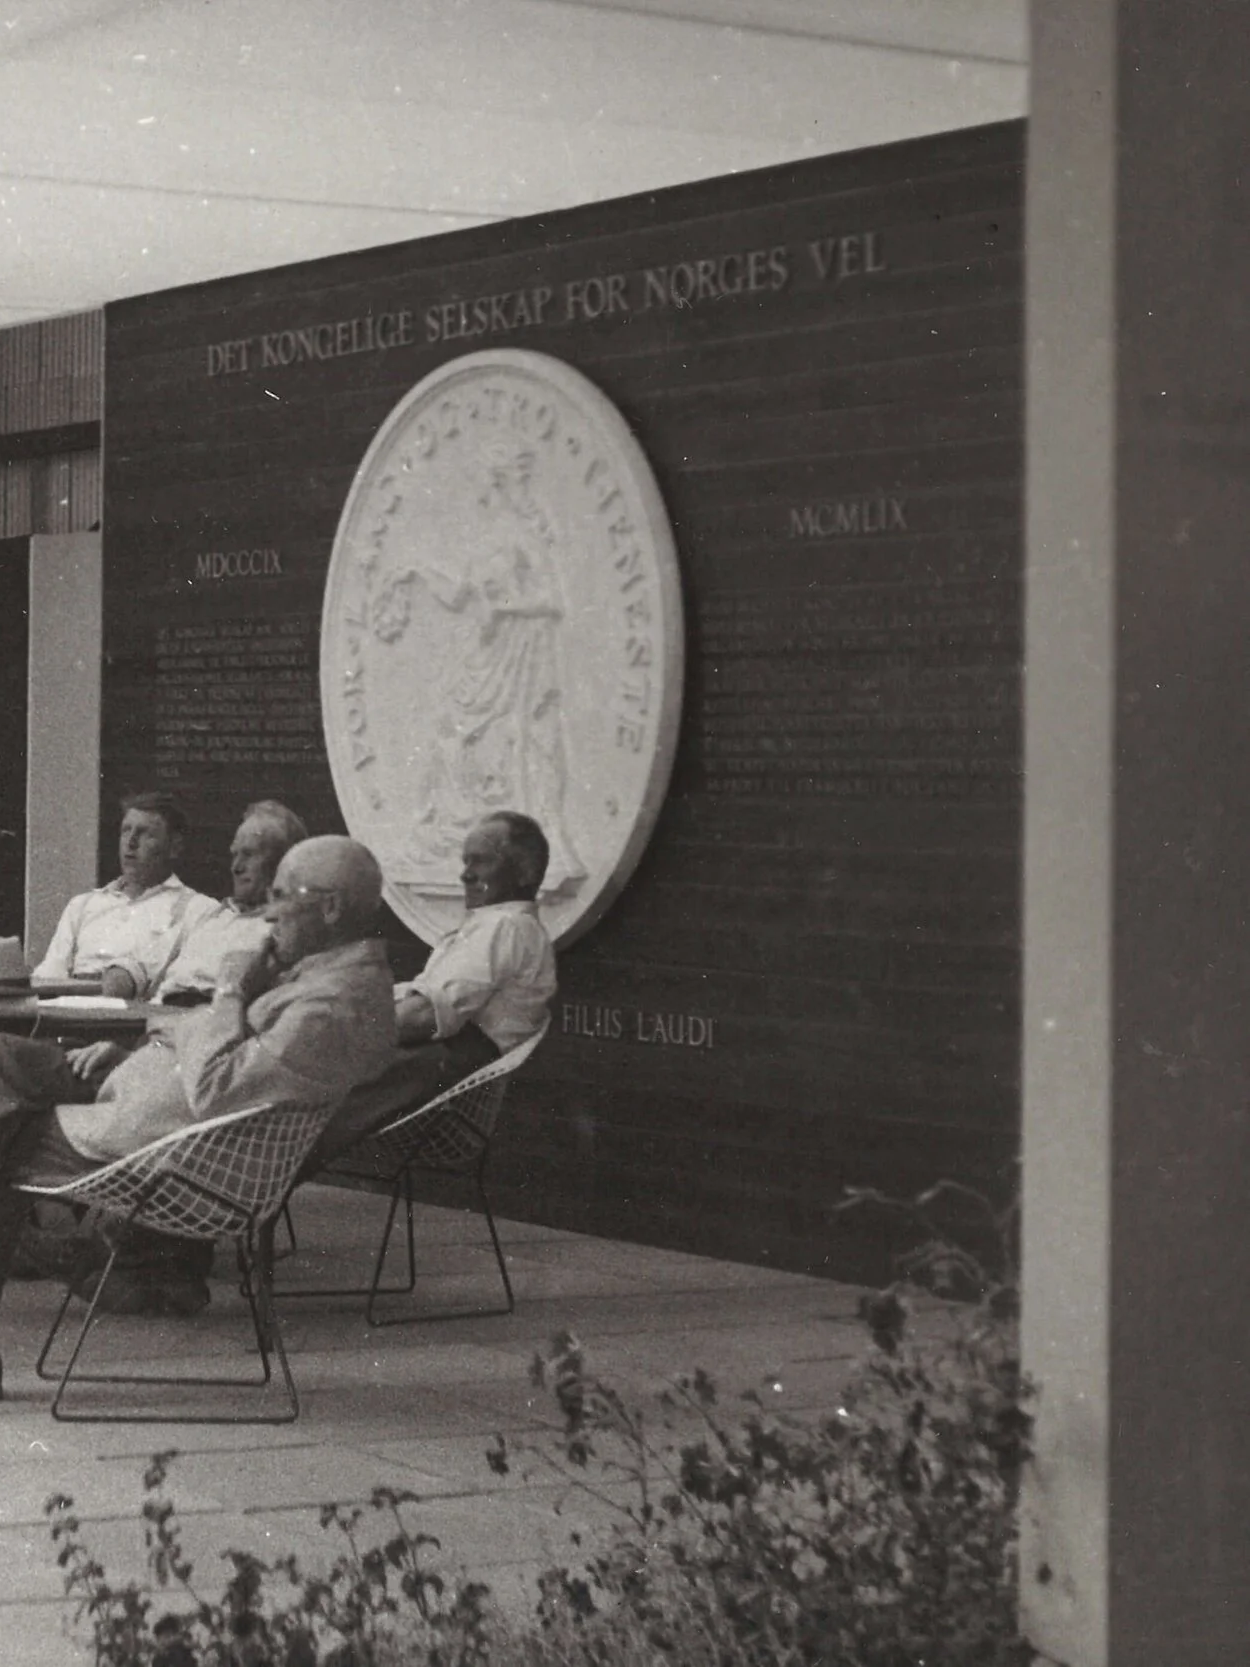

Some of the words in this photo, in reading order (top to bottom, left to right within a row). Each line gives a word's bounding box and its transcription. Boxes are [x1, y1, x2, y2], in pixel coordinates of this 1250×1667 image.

[207, 339, 252, 377] DET
[261, 310, 416, 368] KONGELIGE
[425, 286, 551, 343] SELSKAP
[564, 273, 629, 321] FOR
[643, 245, 789, 309] NORGES
[807, 232, 886, 280] VEL
[788, 497, 908, 538] MCMLIX
[195, 547, 283, 579] MDCCCIX
[561, 1003, 623, 1041] FILIIS
[636, 1011, 716, 1050] LAUDI
